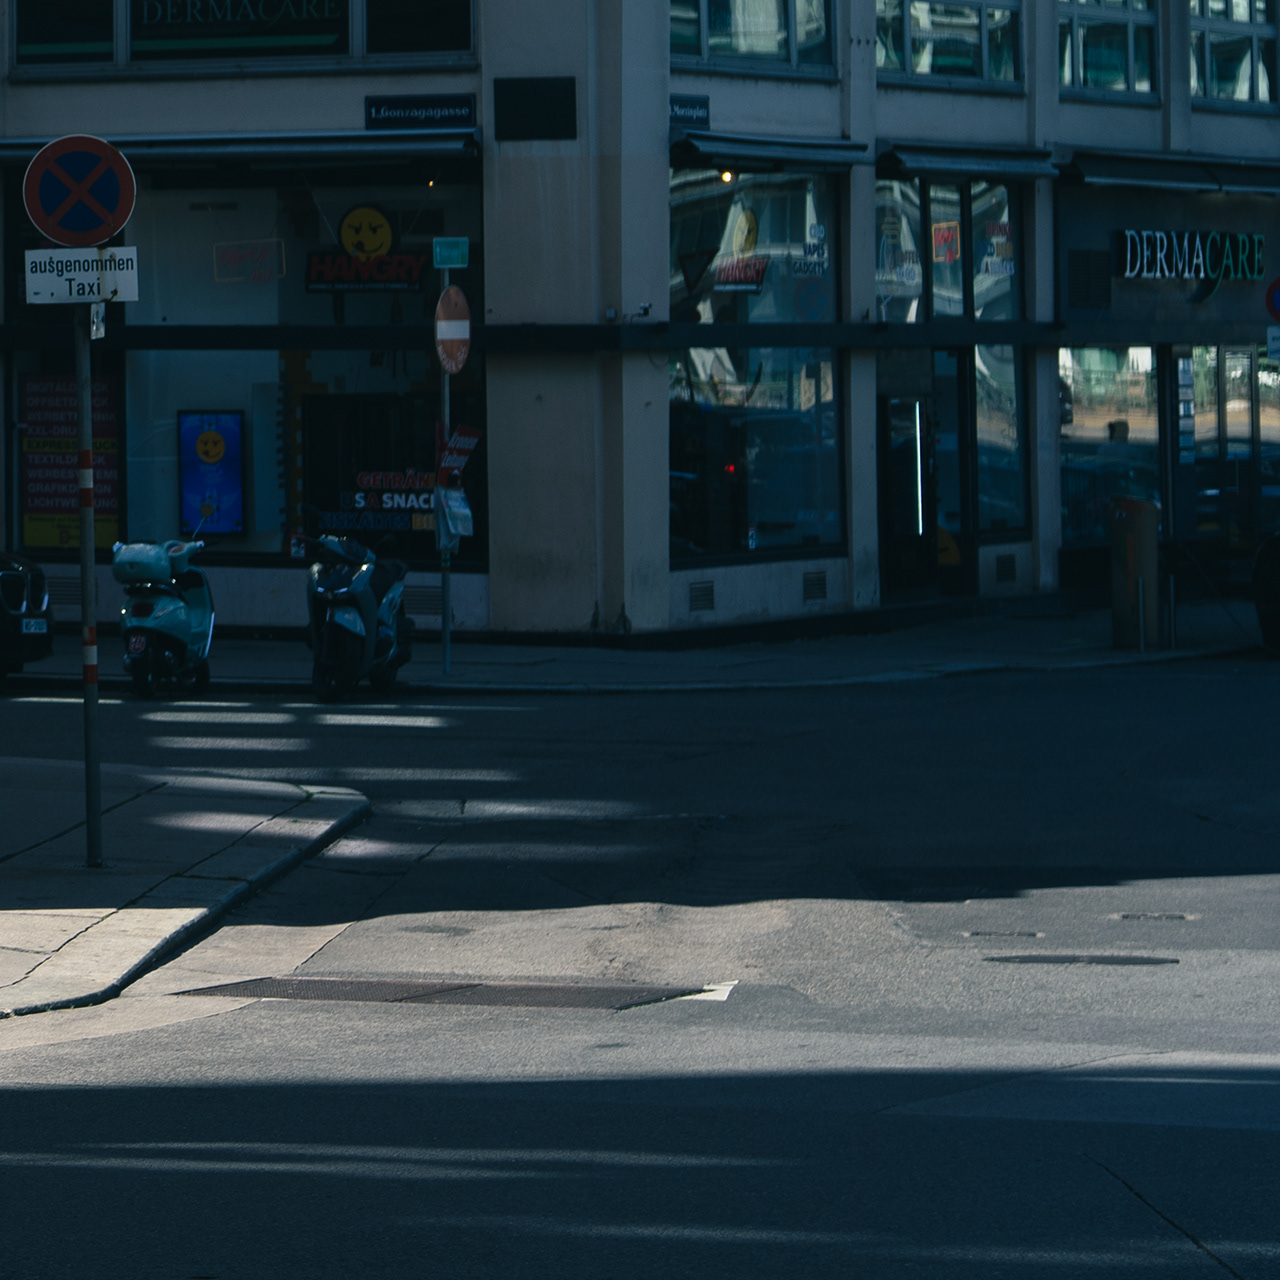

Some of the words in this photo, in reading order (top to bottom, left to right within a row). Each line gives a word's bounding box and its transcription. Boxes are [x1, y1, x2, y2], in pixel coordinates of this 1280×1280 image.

[30, 257, 134, 277] ausgenommen
[309, 254, 428, 282] HANGRY
[715, 256, 770, 283] HANGRY
[1124, 229, 1265, 302] DERMACARE
[65, 277, 101, 296] Taxi
[357, 467, 436, 489] GETRÄN
